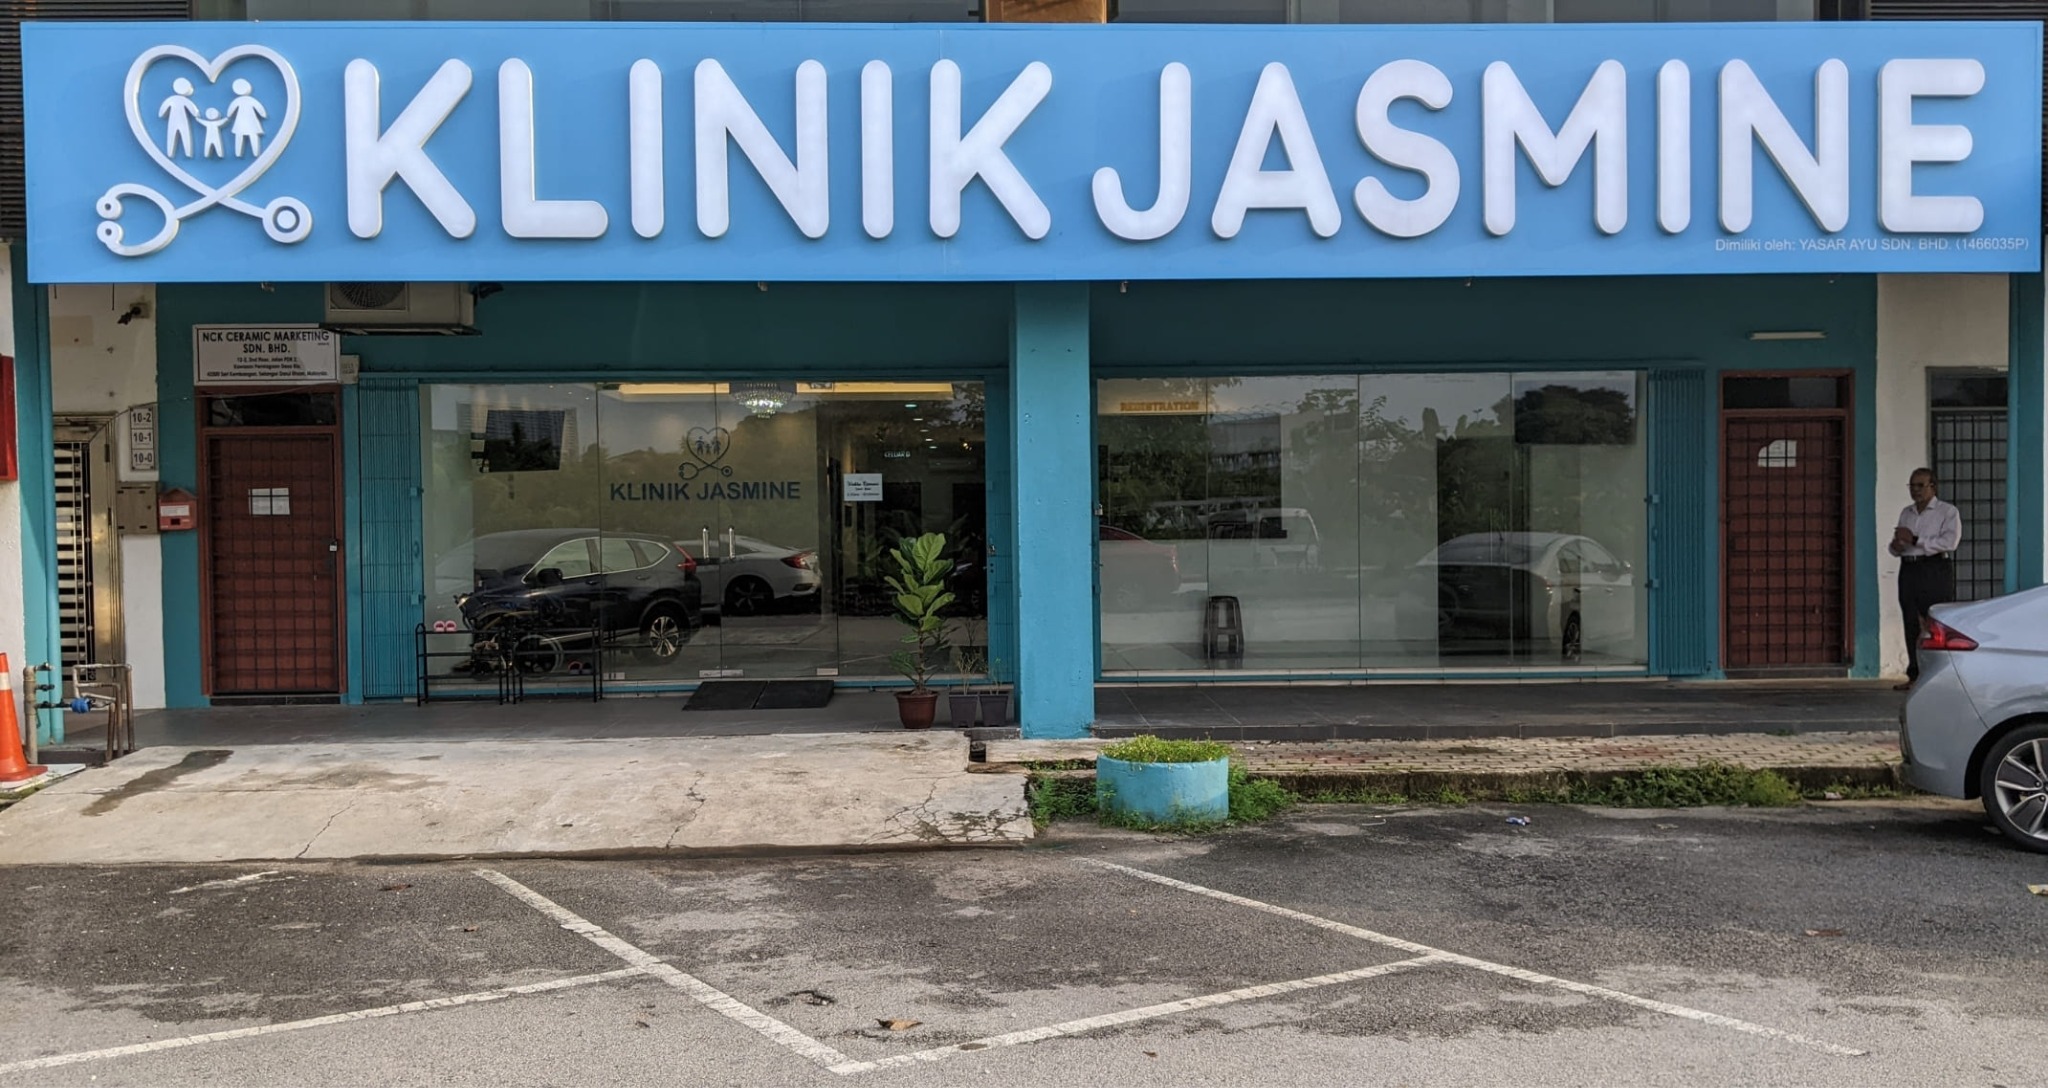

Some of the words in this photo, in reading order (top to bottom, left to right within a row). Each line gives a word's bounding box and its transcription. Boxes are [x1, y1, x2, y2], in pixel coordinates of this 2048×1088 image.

[344, 57, 1053, 240] KLINIK
[1091, 57, 1986, 242] JASMINE
[1715, 238, 1761, 252] Dimiliki
[1764, 238, 1796, 251] oleh:
[1799, 238, 1846, 251] YASAR
[1849, 238, 1877, 251] AYU
[1881, 238, 1915, 251] SDN.
[1918, 238, 1951, 251] BHD.
[1955, 237, 2030, 251] (1466035P)
[202, 332, 223, 342] NCK
[226, 332, 271, 342] CERAMIC
[273, 331, 330, 341] MARKETING
[243, 343, 265, 353] SDN.
[268, 343, 290, 353] BHD.
[1119, 401, 1199, 411] REGISTRATION
[132, 412, 152, 423] 10-2
[133, 432, 152, 442] 10-1
[133, 452, 153, 463] 10-0
[610, 482, 690, 501] KLINIK
[696, 481, 801, 500] JASMINE
